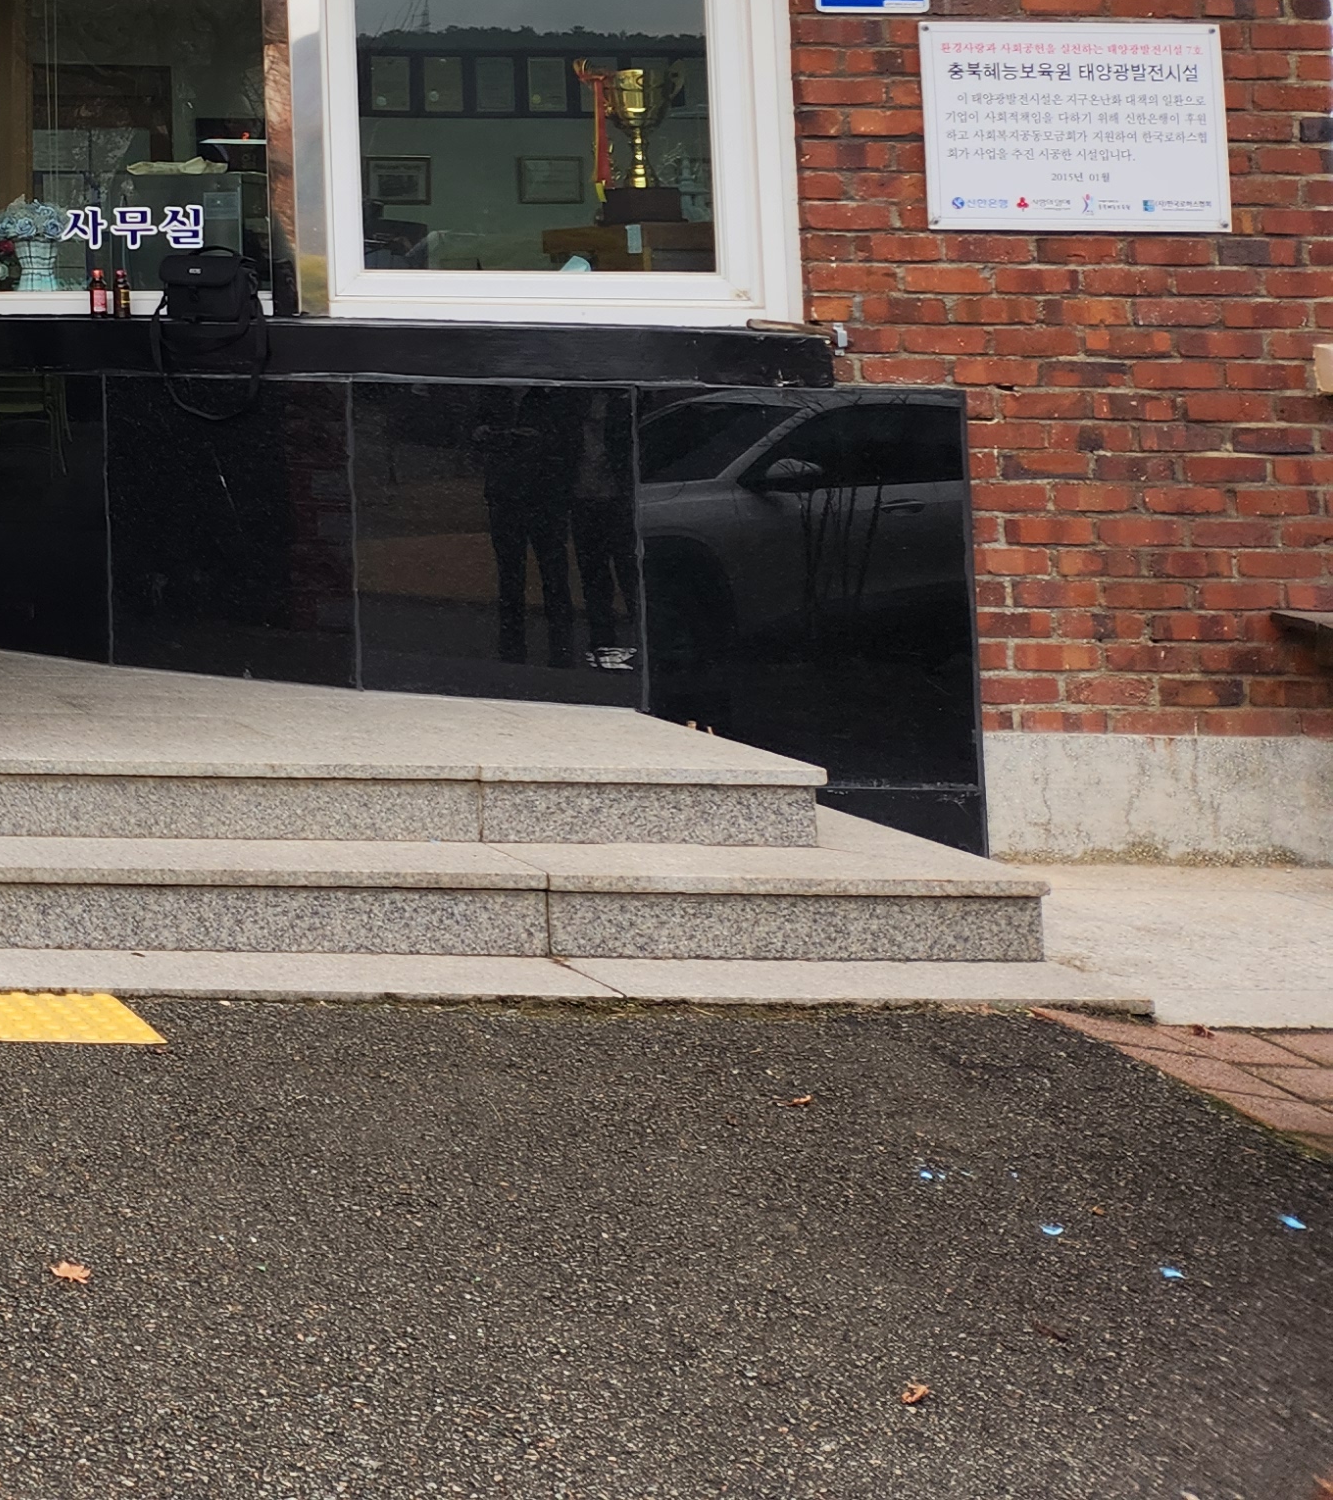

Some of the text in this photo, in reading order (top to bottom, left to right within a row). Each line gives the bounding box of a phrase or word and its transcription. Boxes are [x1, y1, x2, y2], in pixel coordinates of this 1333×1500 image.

[940, 43, 1203, 56] 환경사랑과 사회공헌을 실천하는 태양광발전시설 7호
[948, 62, 1199, 83] 충북혜능보육원 태양광발전시설
[957, 92, 1206, 106] 이 태양광발전시설은 지구온난화 대책의 일환으로
[945, 111, 1207, 125] 기업이 사회적책임을 다하기 위해 신한은행이 후원
[946, 129, 1208, 143] 하고 사회복지공동모금회가 지원하여 한국로하스협
[947, 148, 1135, 161] 회가 사업을 추진 시공한 시설입니다.
[1051, 172, 1110, 182] 2015년 01월
[967, 199, 1008, 208] 신한은행
[61, 204, 206, 249] 사무실
